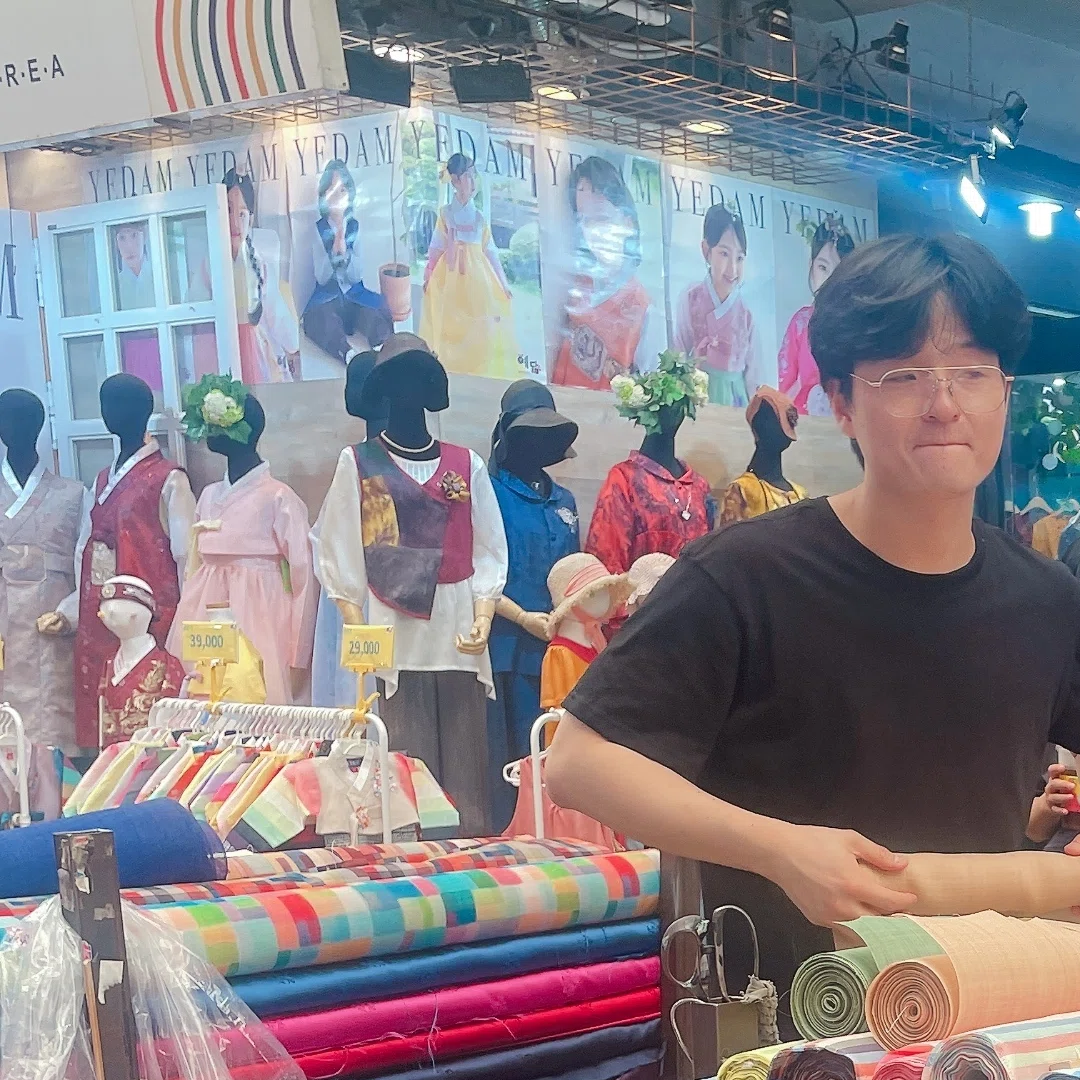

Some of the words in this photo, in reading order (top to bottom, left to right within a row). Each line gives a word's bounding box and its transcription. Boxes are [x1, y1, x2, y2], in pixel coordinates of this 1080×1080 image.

[89, 159, 173, 203] YEDAM
[190, 634, 224, 650] 39,000
[349, 640, 381, 657] 29,000
